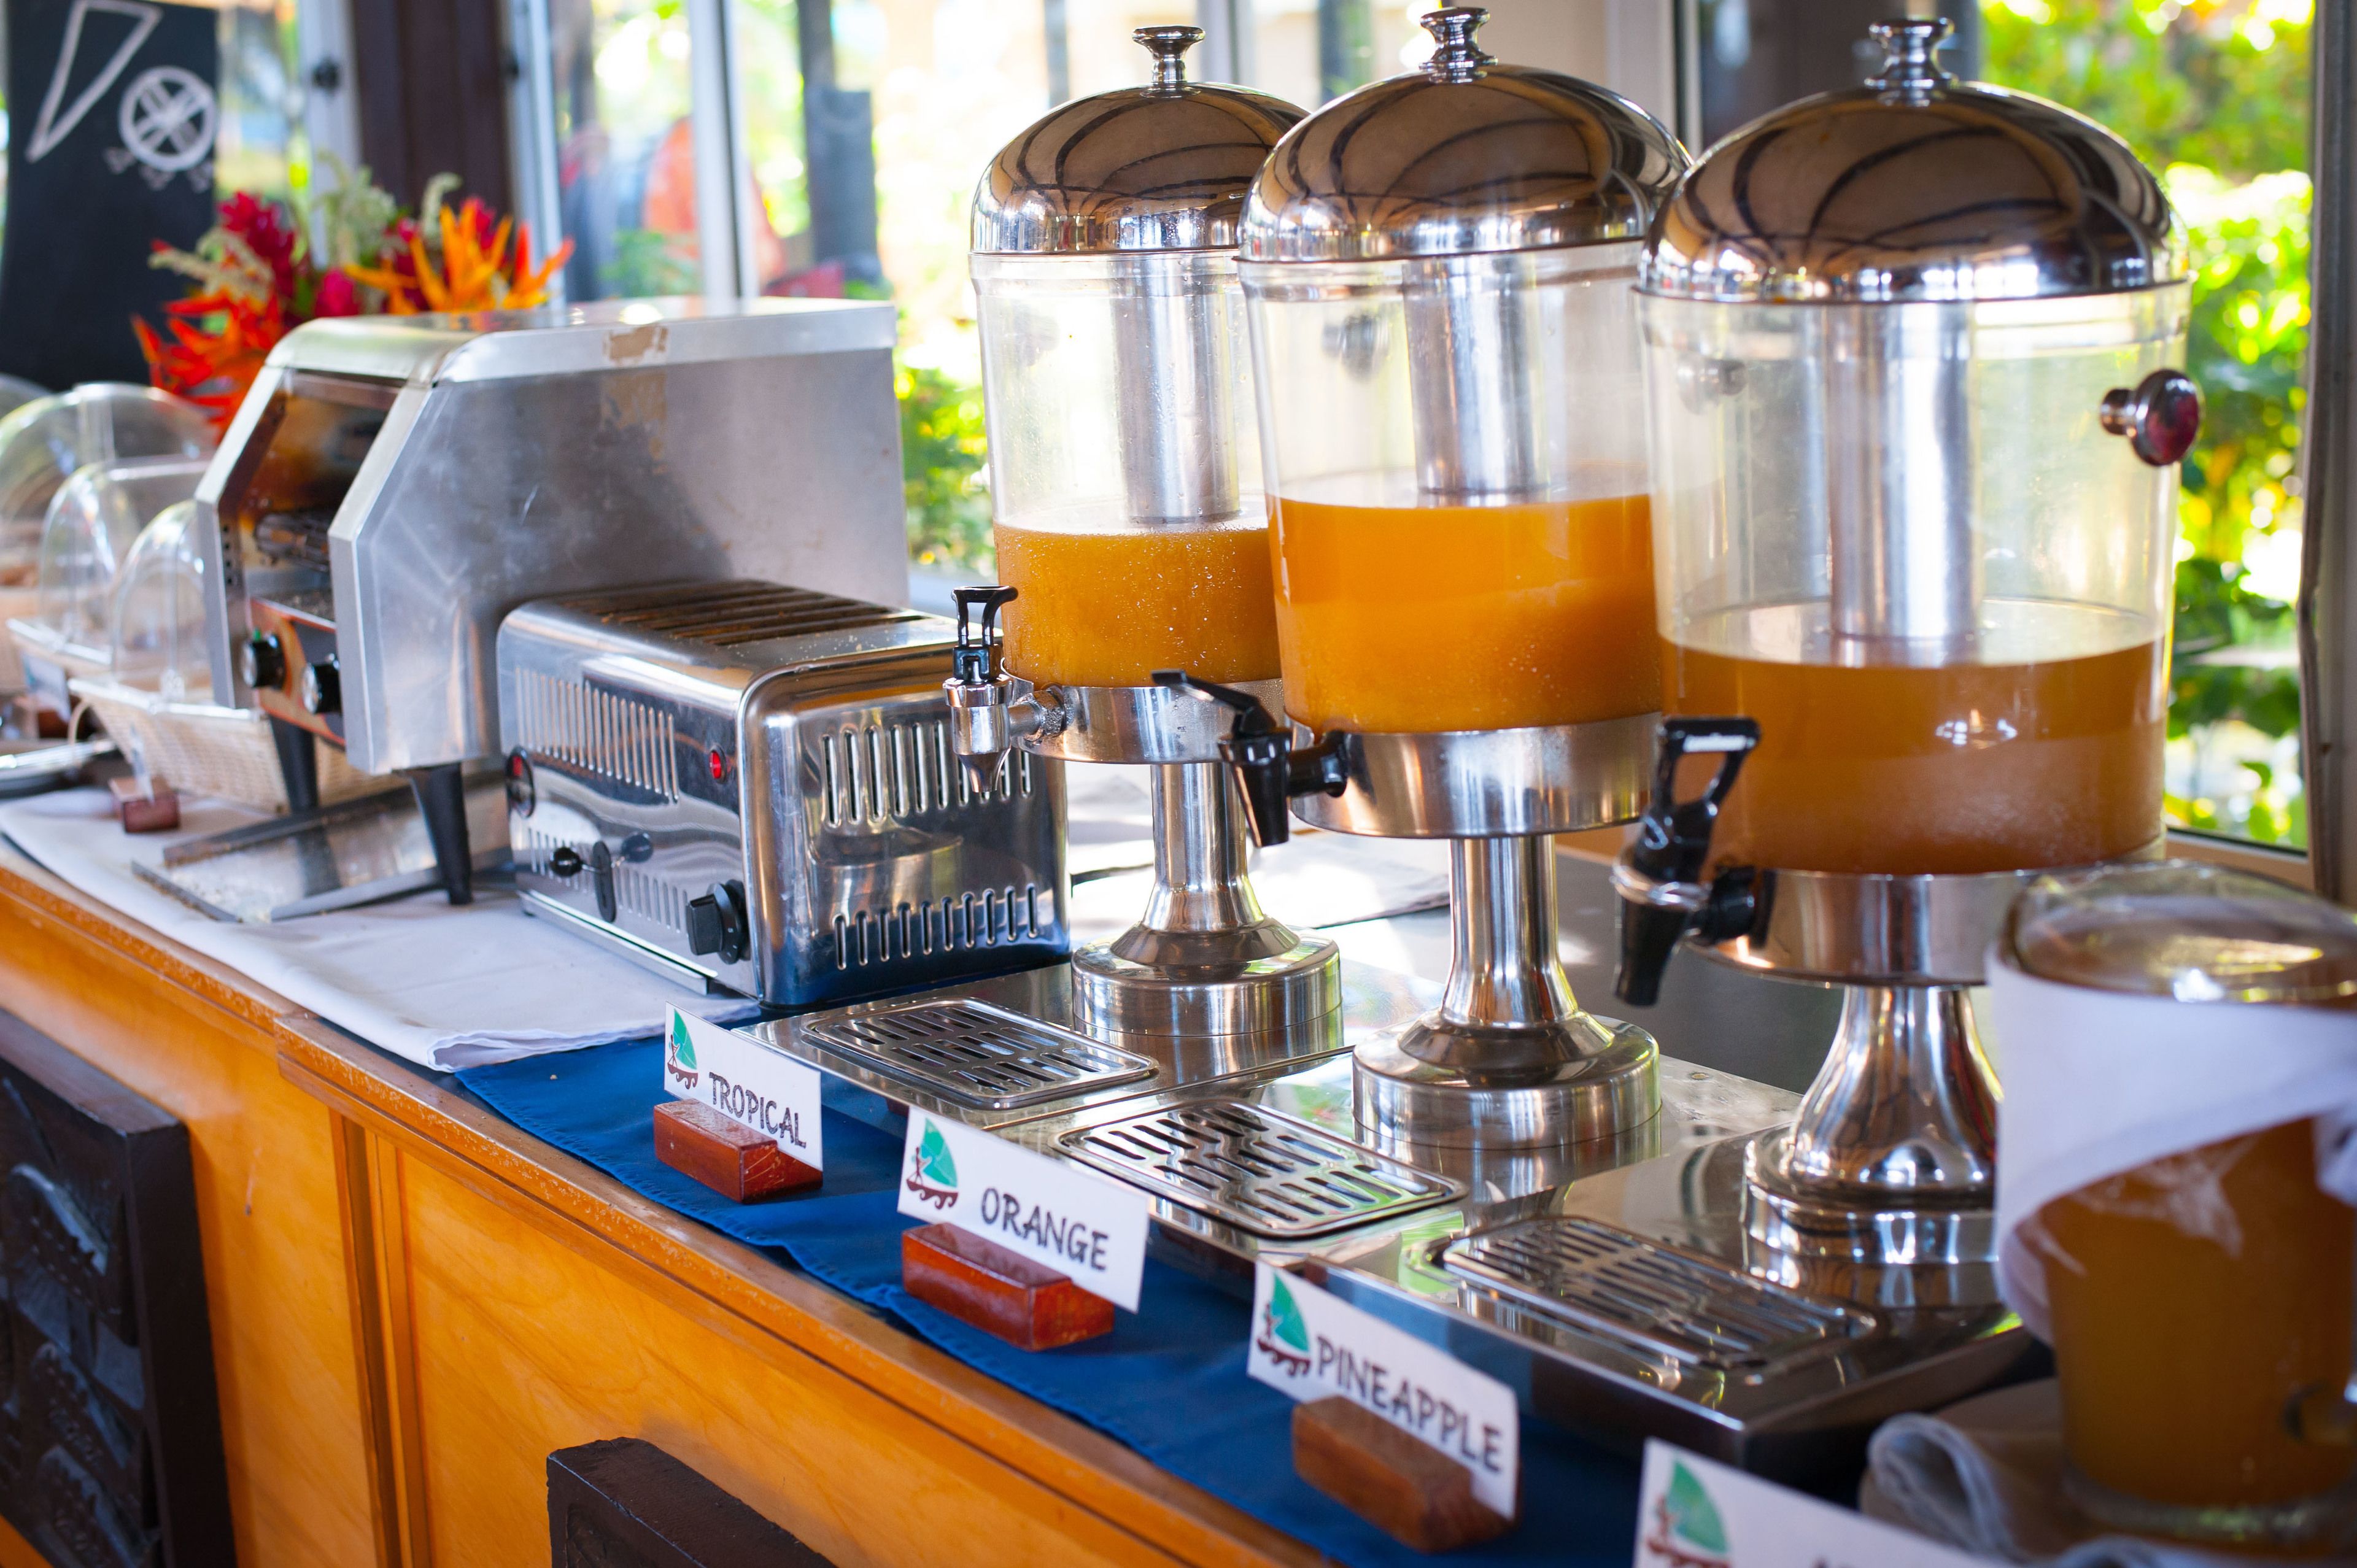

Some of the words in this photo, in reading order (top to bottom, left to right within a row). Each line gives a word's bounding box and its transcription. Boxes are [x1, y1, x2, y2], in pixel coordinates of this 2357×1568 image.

[708, 1072, 807, 1149] TROPICAL
[981, 1188, 1109, 1271] ORANGE
[1317, 1335, 1501, 1472] PINEAPPLE
